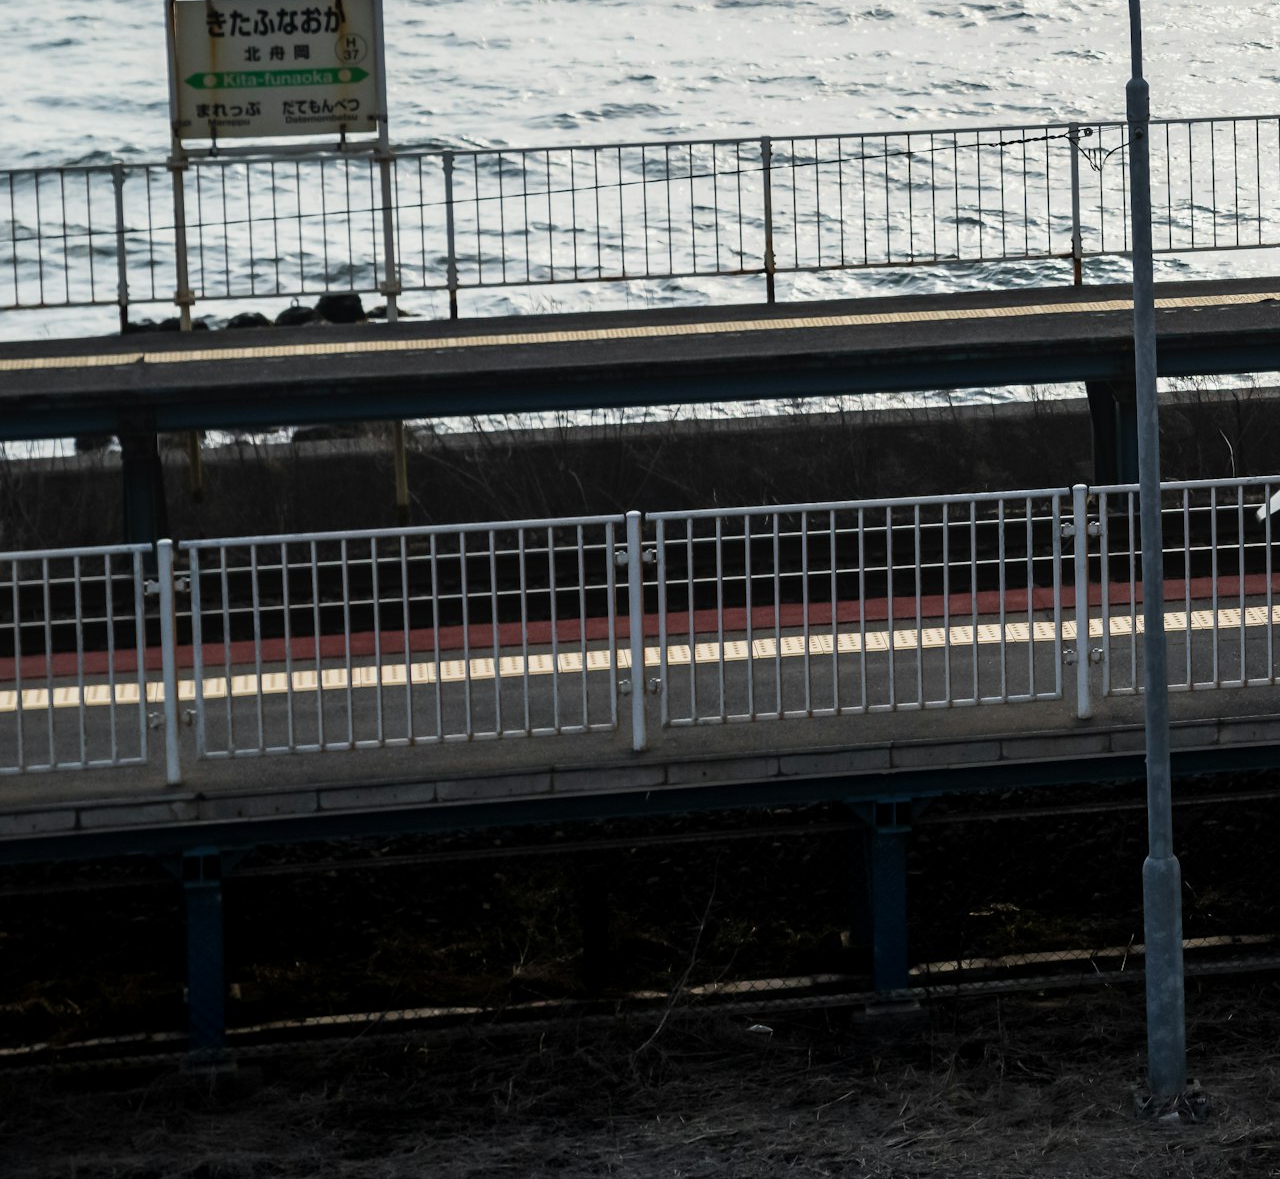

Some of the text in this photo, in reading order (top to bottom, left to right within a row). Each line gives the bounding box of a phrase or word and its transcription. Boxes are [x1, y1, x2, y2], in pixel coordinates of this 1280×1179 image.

[206, 6, 346, 38] きたふなおか
[345, 37, 357, 49] H
[244, 44, 311, 63] 北舟岡
[342, 49, 360, 62] 37
[222, 69, 334, 88] Kita-funaoka
[282, 98, 360, 115] だてもんべつ
